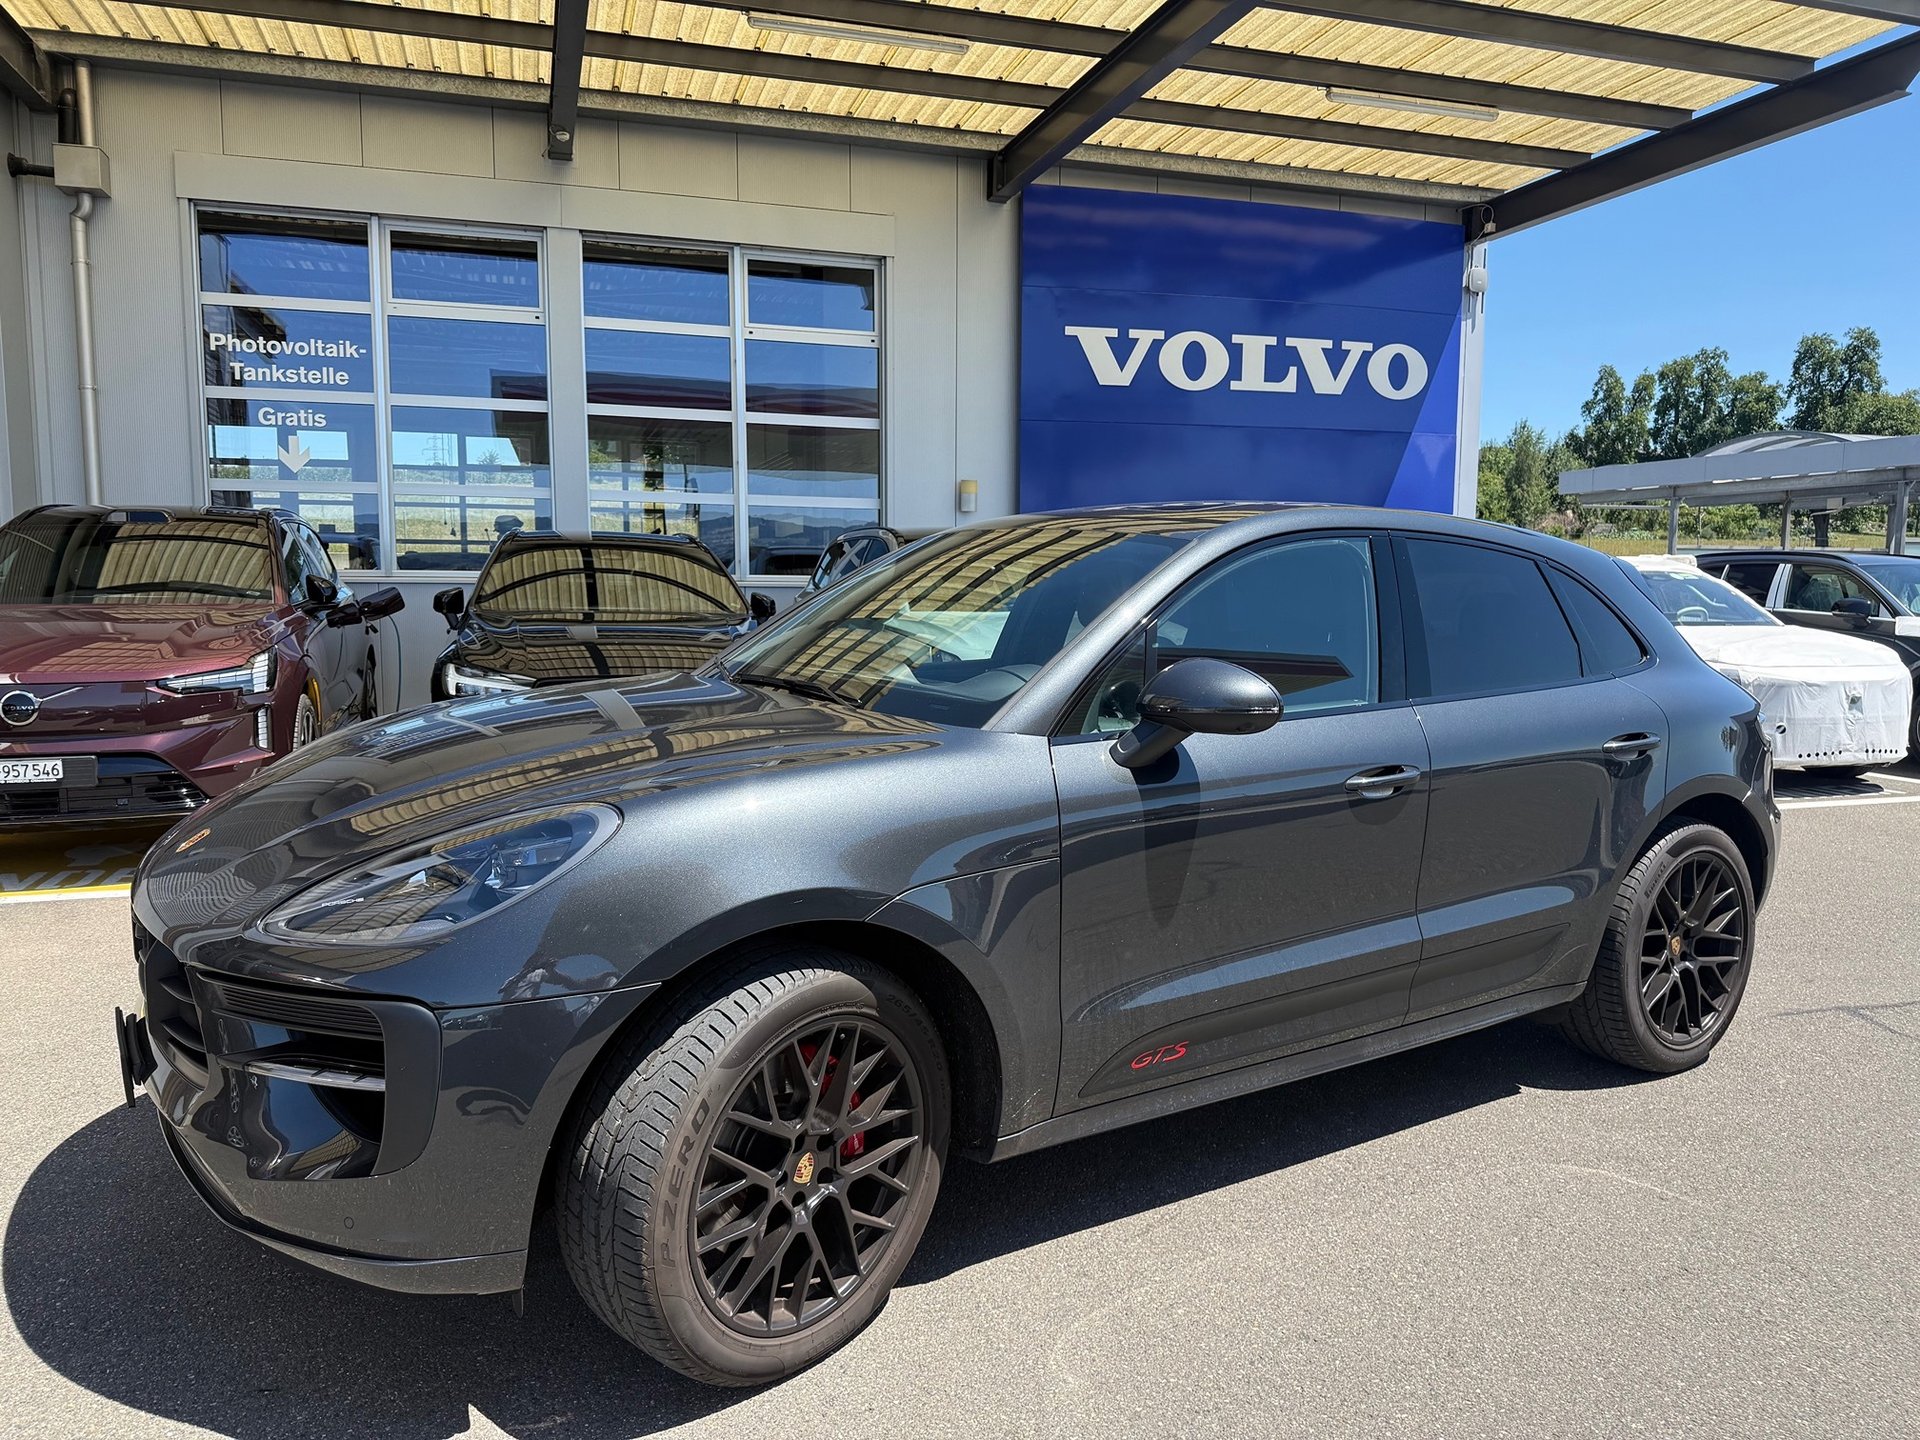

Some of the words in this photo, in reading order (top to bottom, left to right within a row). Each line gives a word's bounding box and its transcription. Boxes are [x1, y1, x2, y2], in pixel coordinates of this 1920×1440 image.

[209, 333, 367, 358] Photovoltaik-
[229, 362, 350, 385] Tankstelle
[1064, 325, 1429, 400] VOLVO
[257, 406, 327, 427] Gratis
[1131, 1041, 1189, 1069] GTS
[662, 1097, 710, 1232] ZERO
